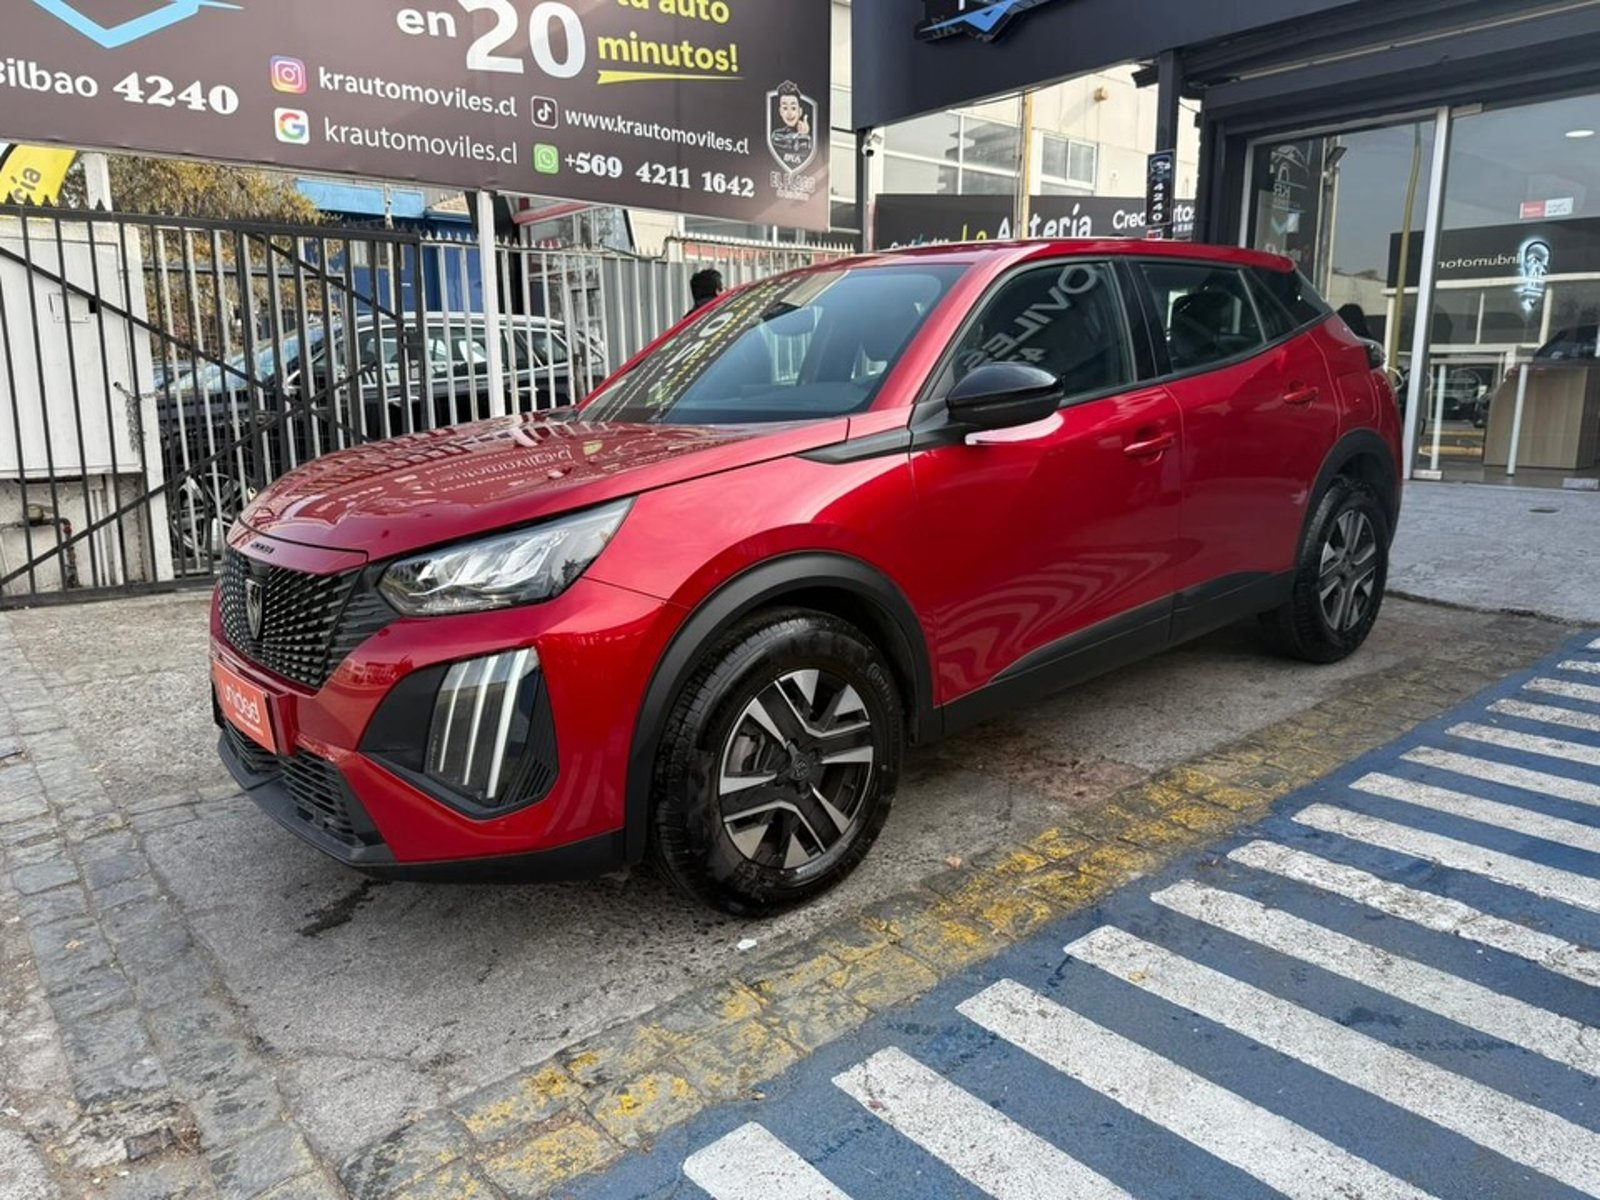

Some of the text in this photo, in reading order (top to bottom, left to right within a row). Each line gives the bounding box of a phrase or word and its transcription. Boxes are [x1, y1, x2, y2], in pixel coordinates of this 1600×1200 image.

[395, 0, 587, 79] en 20
[596, 31, 739, 74] minutos!
[0, 57, 241, 116] ilbao 4240
[318, 66, 519, 118] krautomoviles.cl
[323, 115, 519, 166] krautomoviles.cl
[564, 109, 751, 156] www.krautomoviles.cl
[564, 151, 624, 180] +569
[634, 161, 692, 190] 4211
[701, 171, 757, 199] 1642
